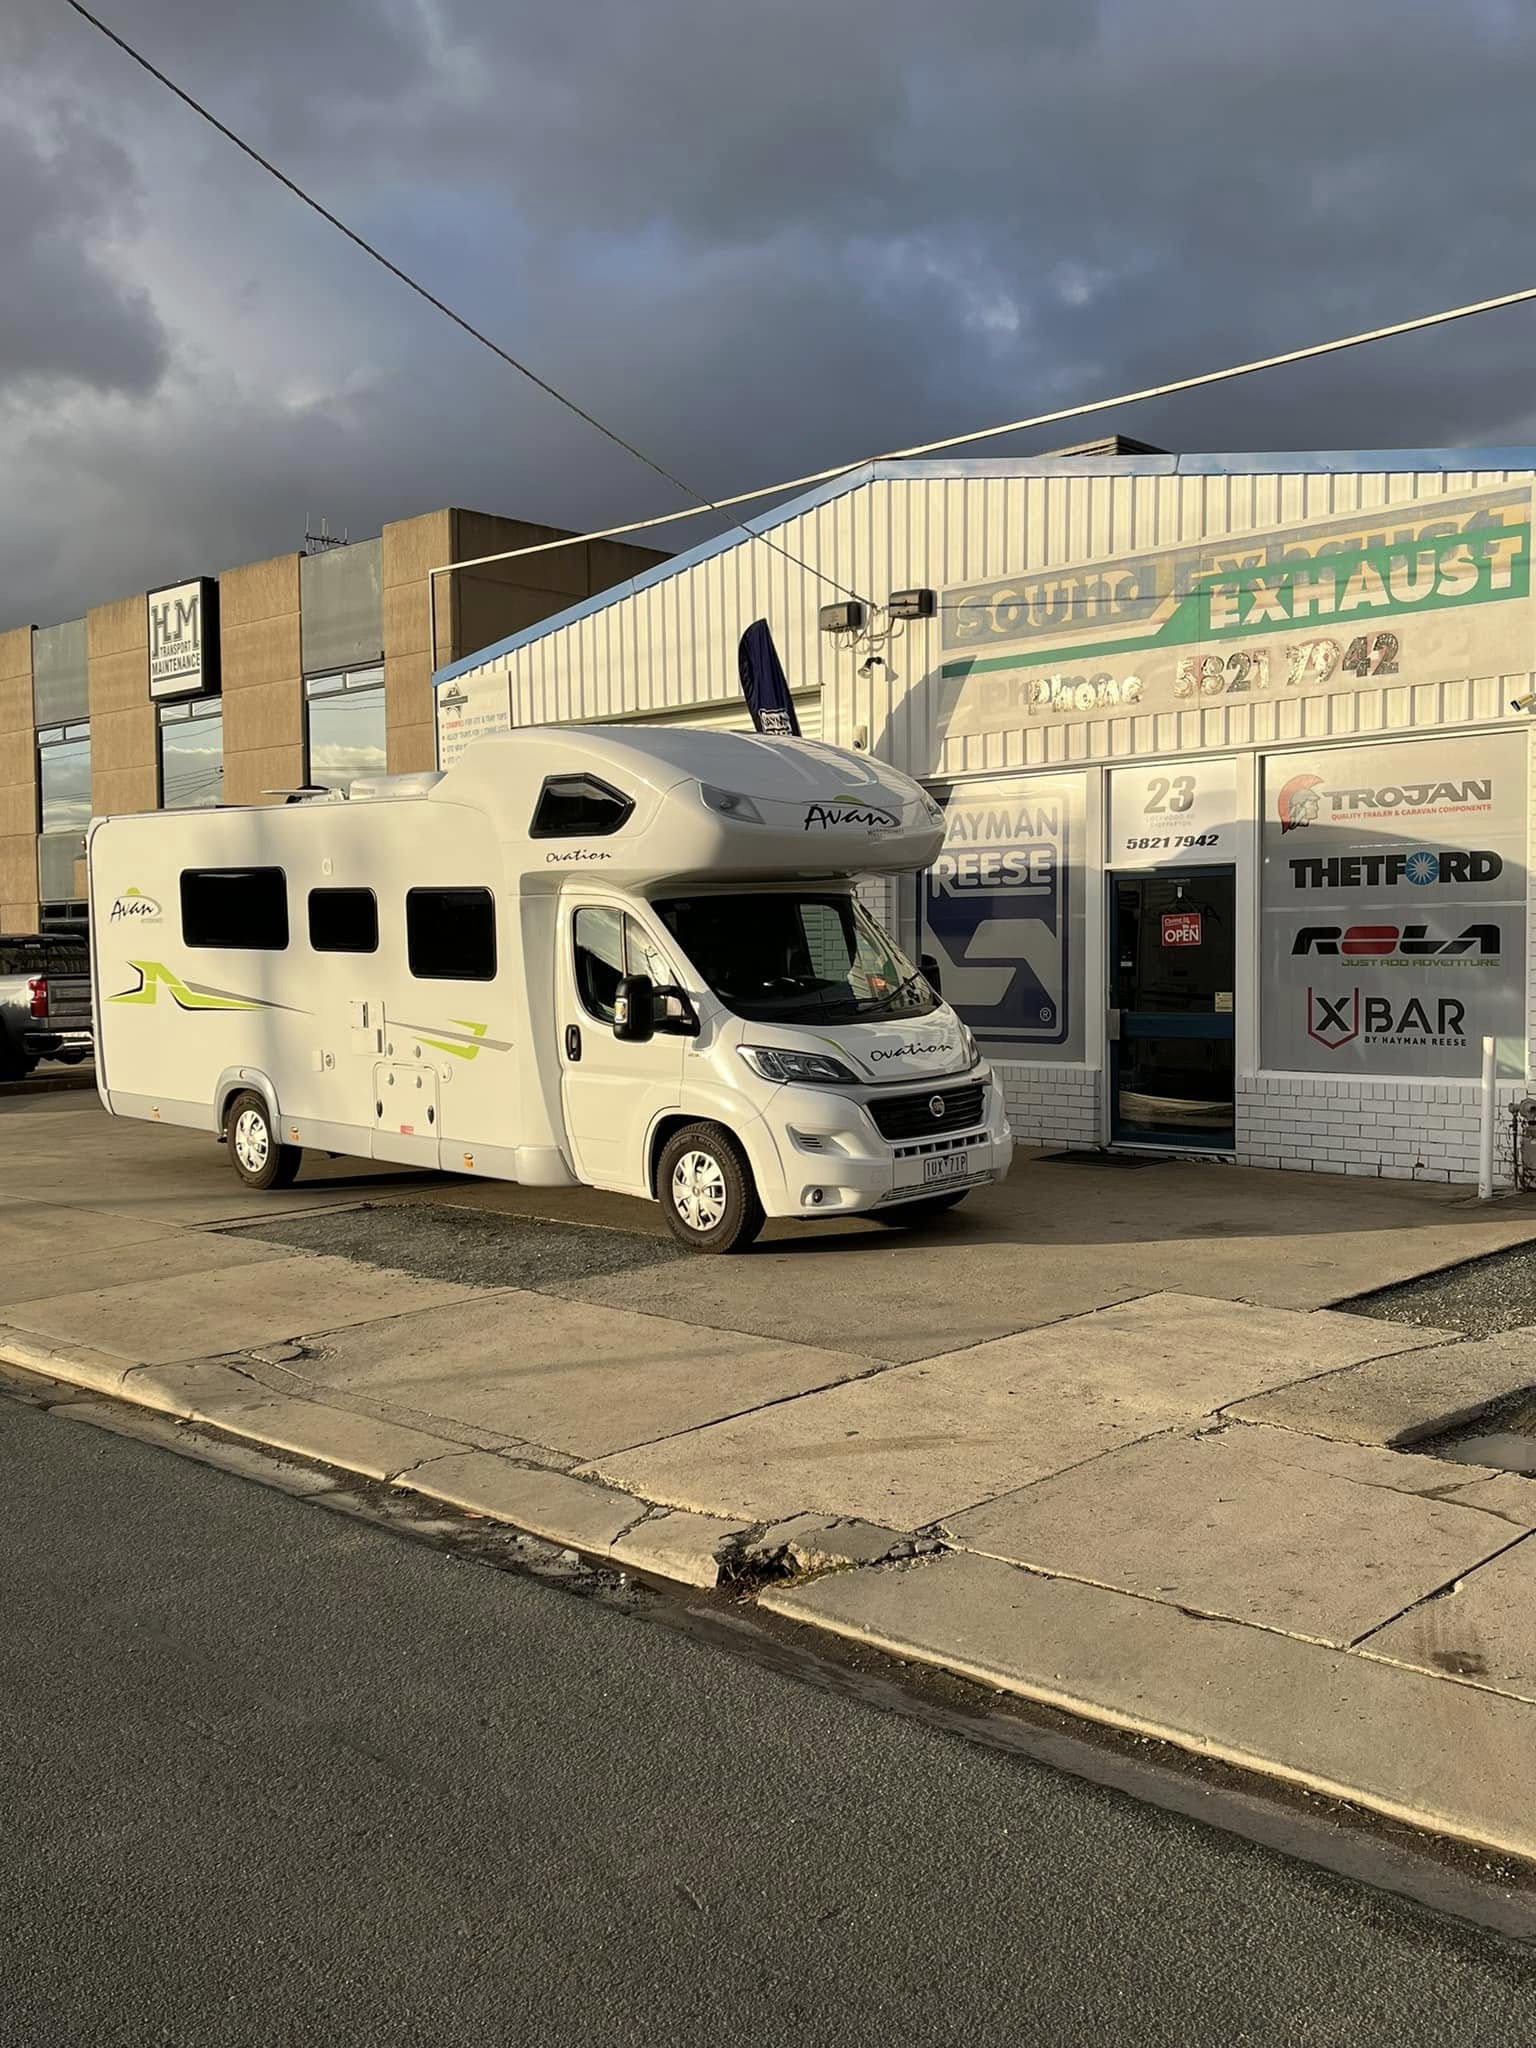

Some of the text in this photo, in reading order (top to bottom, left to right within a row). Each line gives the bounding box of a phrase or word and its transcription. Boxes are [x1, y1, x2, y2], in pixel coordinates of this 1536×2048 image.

[1210, 536, 1523, 630] EXHAUST
[160, 640, 191, 657] TRANSPORT
[152, 653, 200, 675] MAINTENANCE
[1028, 673, 1143, 715] Phone
[1144, 776, 1196, 814] 23
[1323, 780, 1491, 811] TROJAN
[804, 804, 889, 831] Avan
[948, 807, 1058, 841] AYMAN
[1331, 812, 1361, 821] QUALITY
[1363, 810, 1393, 819] TRAILER
[1401, 807, 1437, 816] CARAVAN
[1438, 804, 1491, 814] COMPONENTS
[932, 850, 1051, 898] REESE
[1289, 850, 1503, 888] THETFORD
[110, 900, 154, 923] Avan
[1165, 929, 1199, 942] OPEN
[1291, 924, 1500, 955] ROLA
[1342, 958, 1500, 967] JUST ADD ADVENTURE
[1365, 1036, 1467, 1047] BY HAYMAN REESE
